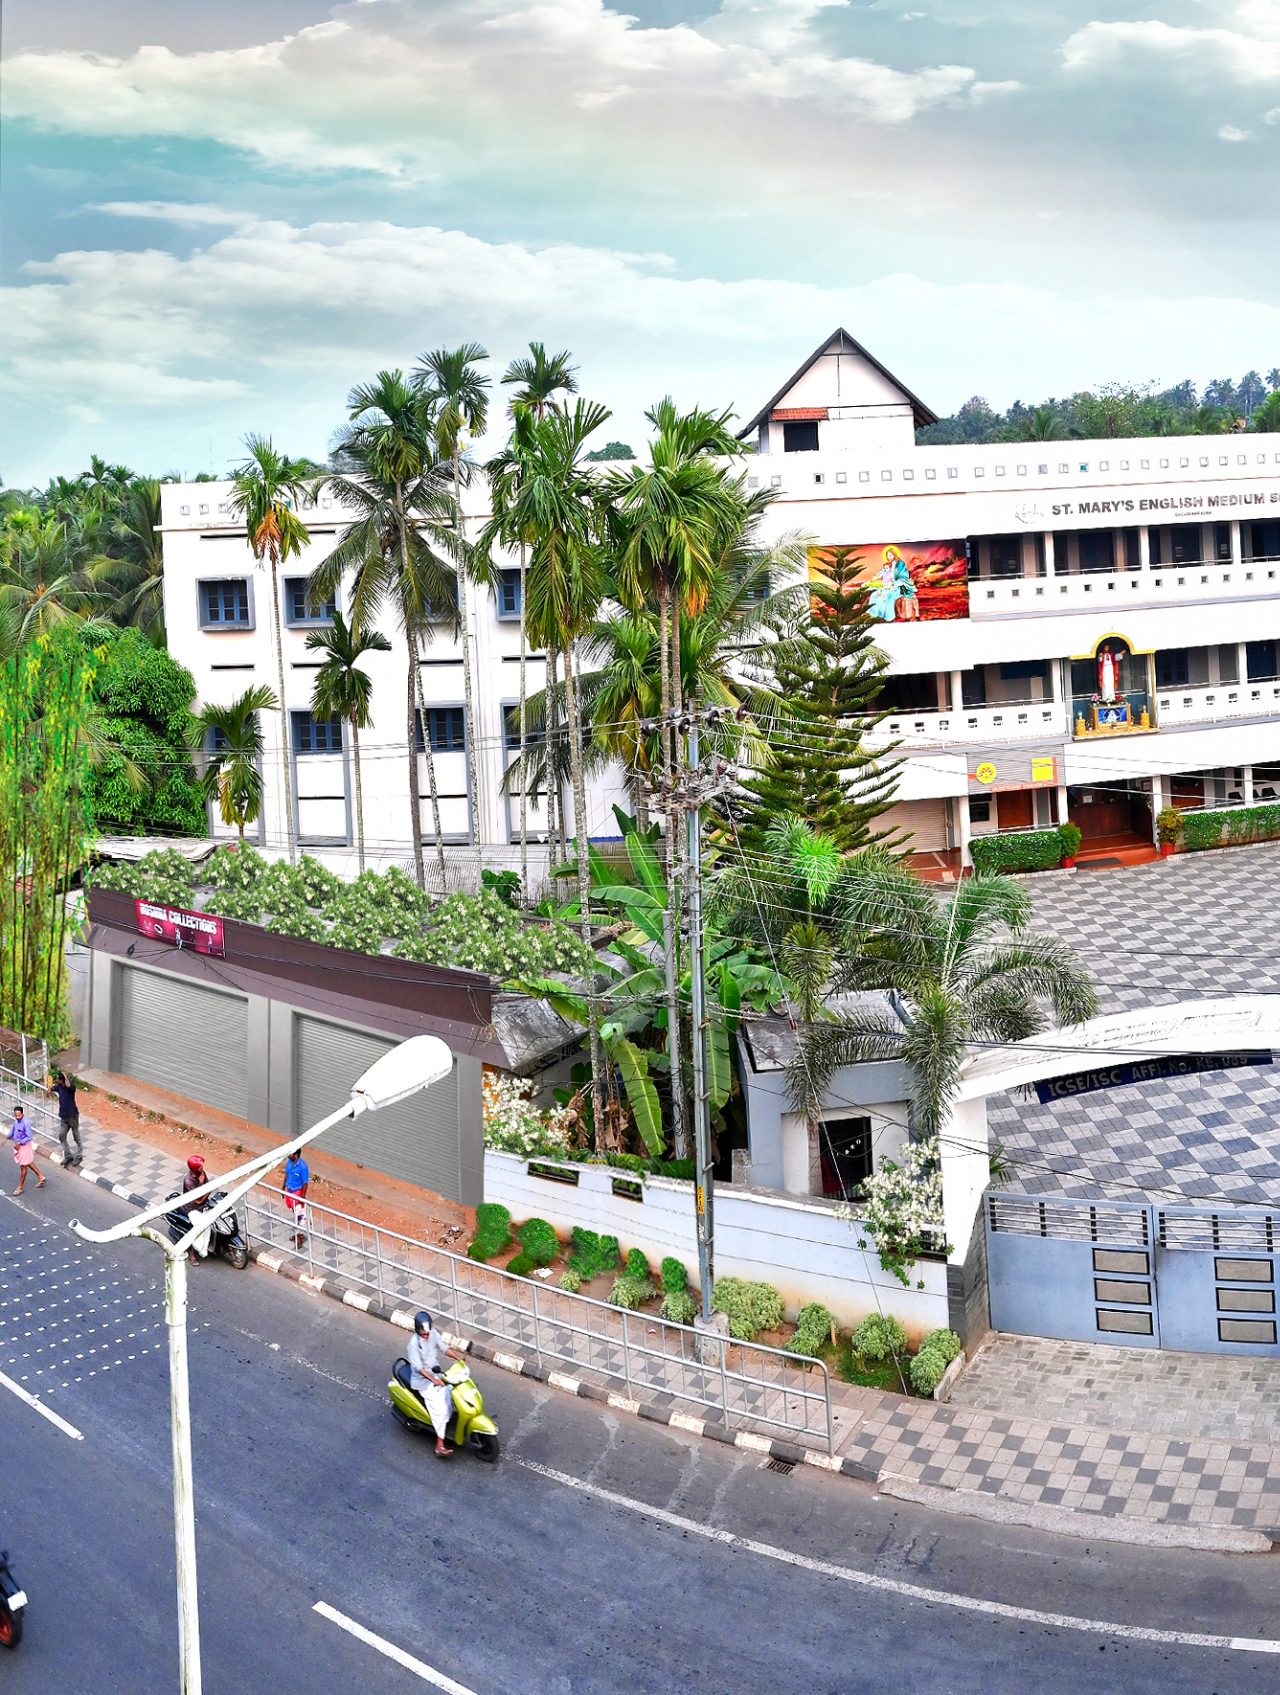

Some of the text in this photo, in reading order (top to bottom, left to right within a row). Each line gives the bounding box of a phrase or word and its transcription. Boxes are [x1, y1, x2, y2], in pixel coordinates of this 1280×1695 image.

[1051, 503, 1074, 516] ST.
[1078, 500, 1135, 514] MARY'S
[1139, 496, 1203, 511] ENGLISH
[1207, 493, 1265, 508] MEDIUM
[168, 911, 218, 935] COLLECTIONS
[1047, 1069, 1122, 1097] ICSE/ISC
